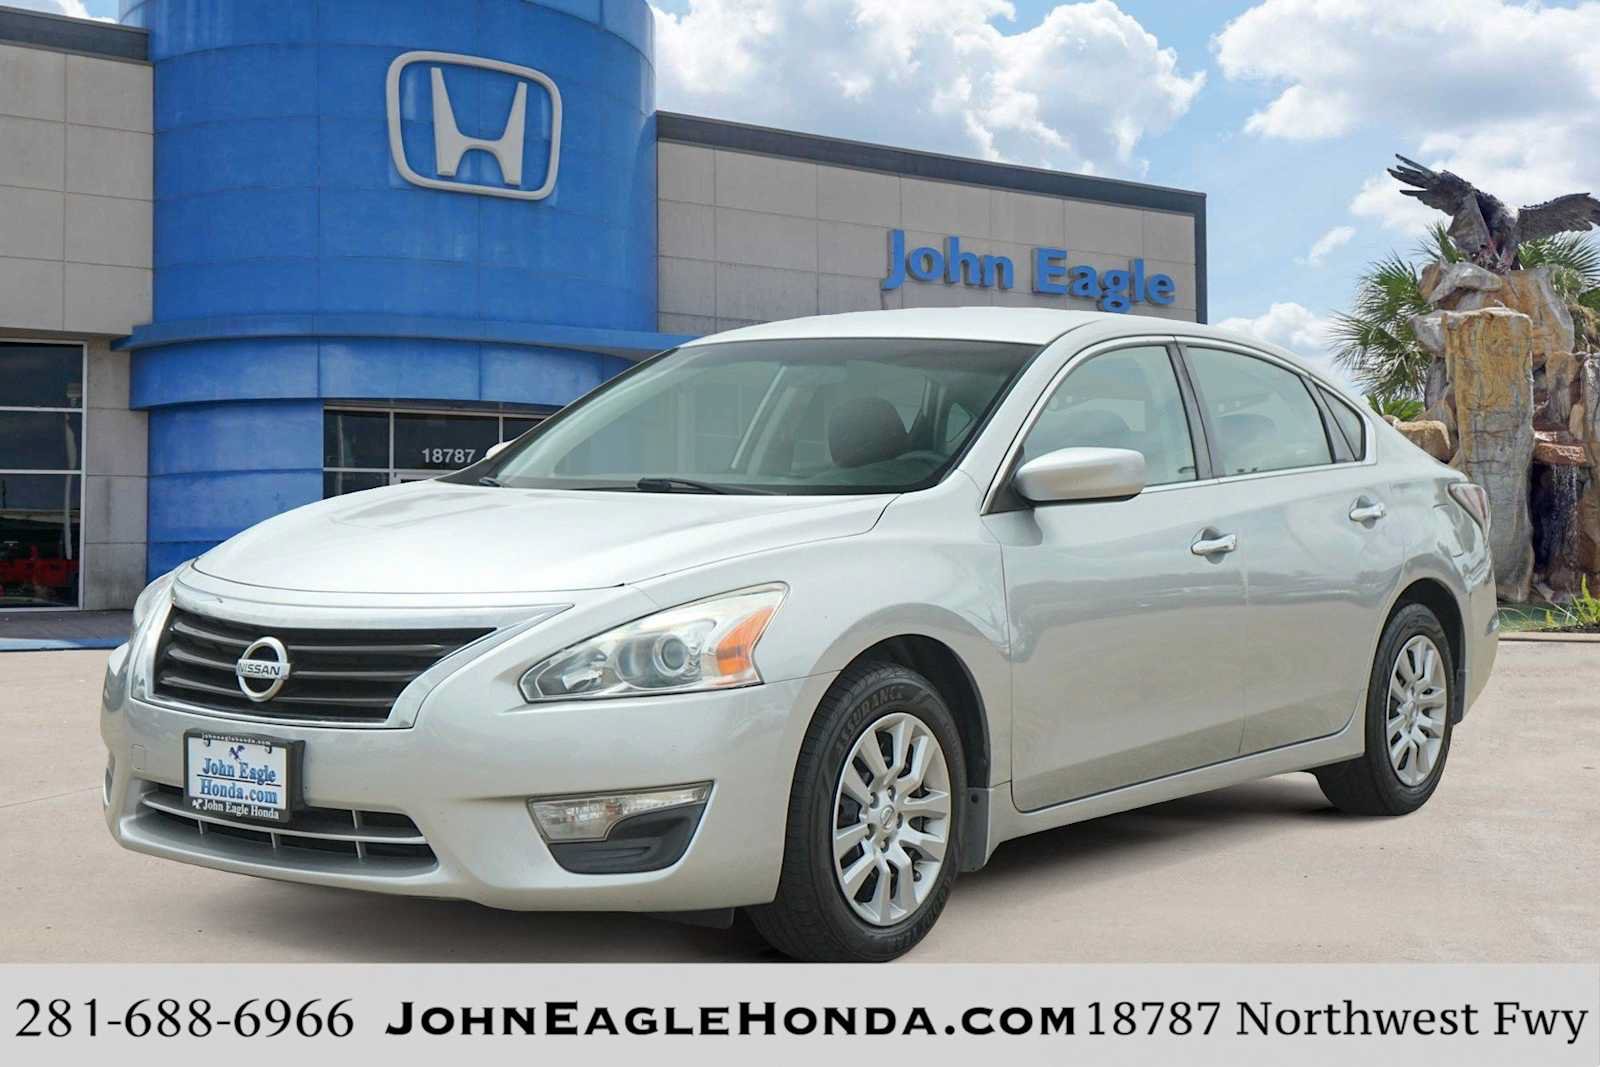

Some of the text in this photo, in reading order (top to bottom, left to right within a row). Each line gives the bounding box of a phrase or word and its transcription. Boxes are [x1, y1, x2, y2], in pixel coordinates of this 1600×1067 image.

[879, 228, 1176, 313] John Eagle
[421, 448, 476, 463] 18787
[239, 661, 281, 676] NISSAN
[202, 758, 276, 785] John Eagle
[200, 778, 278, 805] Honda.com
[203, 799, 280, 820] John Eagle Honda
